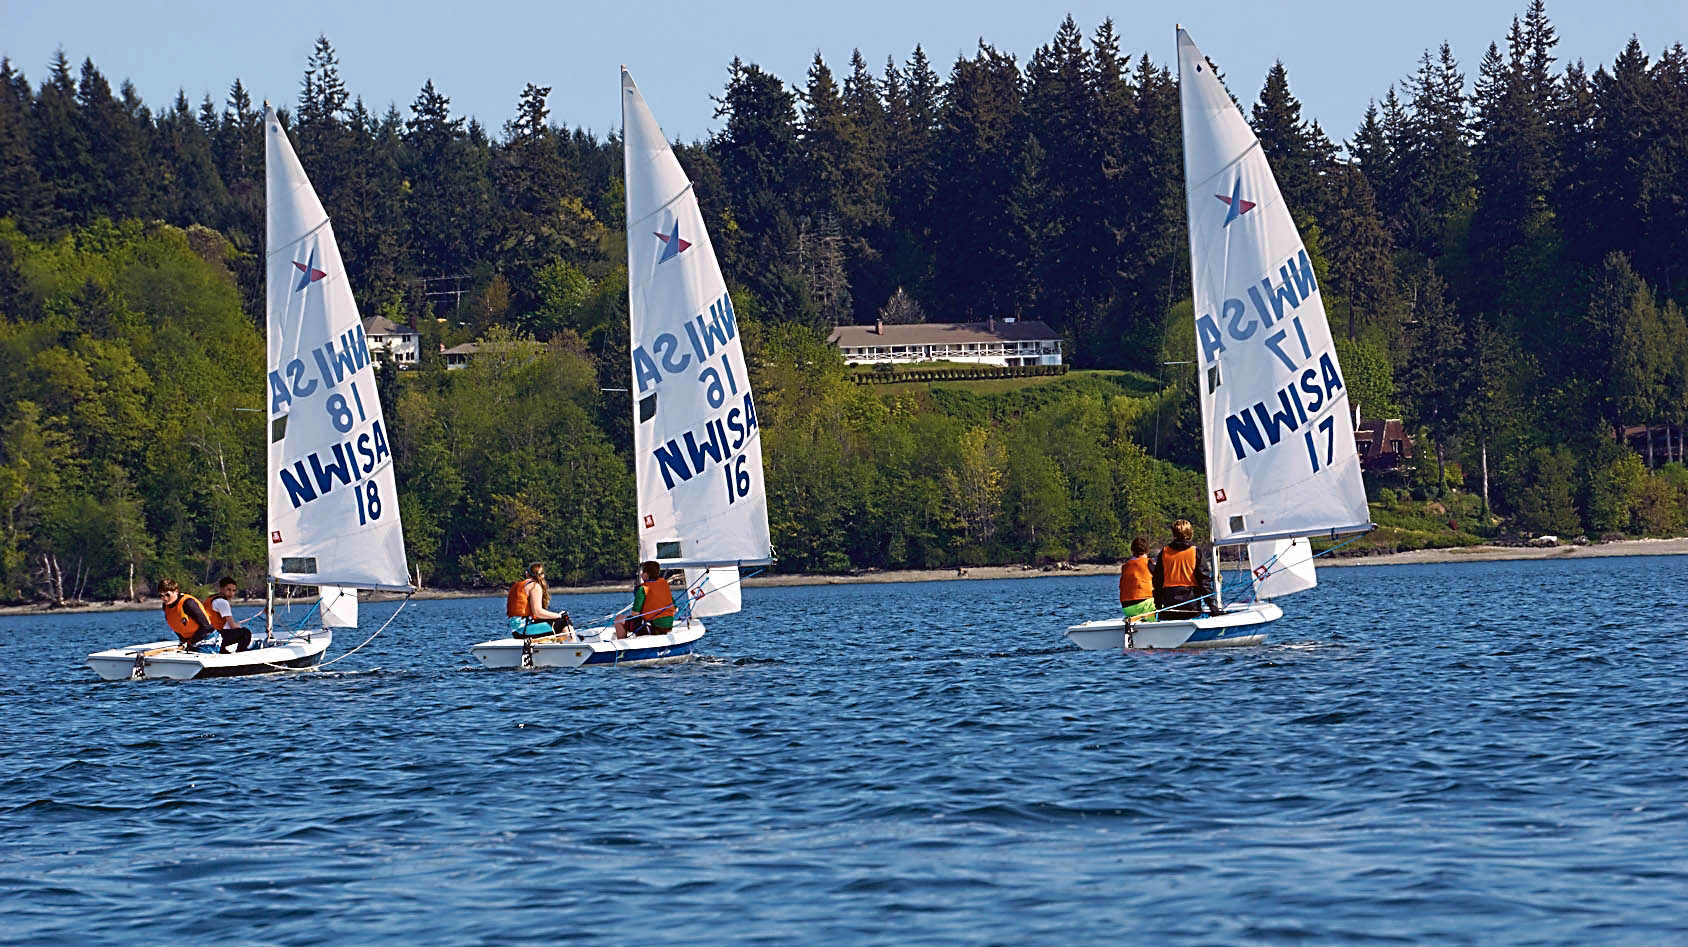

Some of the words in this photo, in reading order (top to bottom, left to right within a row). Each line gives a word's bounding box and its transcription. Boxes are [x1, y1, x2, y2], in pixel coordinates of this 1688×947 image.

[653, 392, 758, 491] NWISA
[1225, 352, 1343, 461] NWISA
[279, 419, 389, 509] NWISA
[724, 454, 750, 505] 16
[1305, 415, 1334, 474] 17
[354, 479, 382, 526] 18
